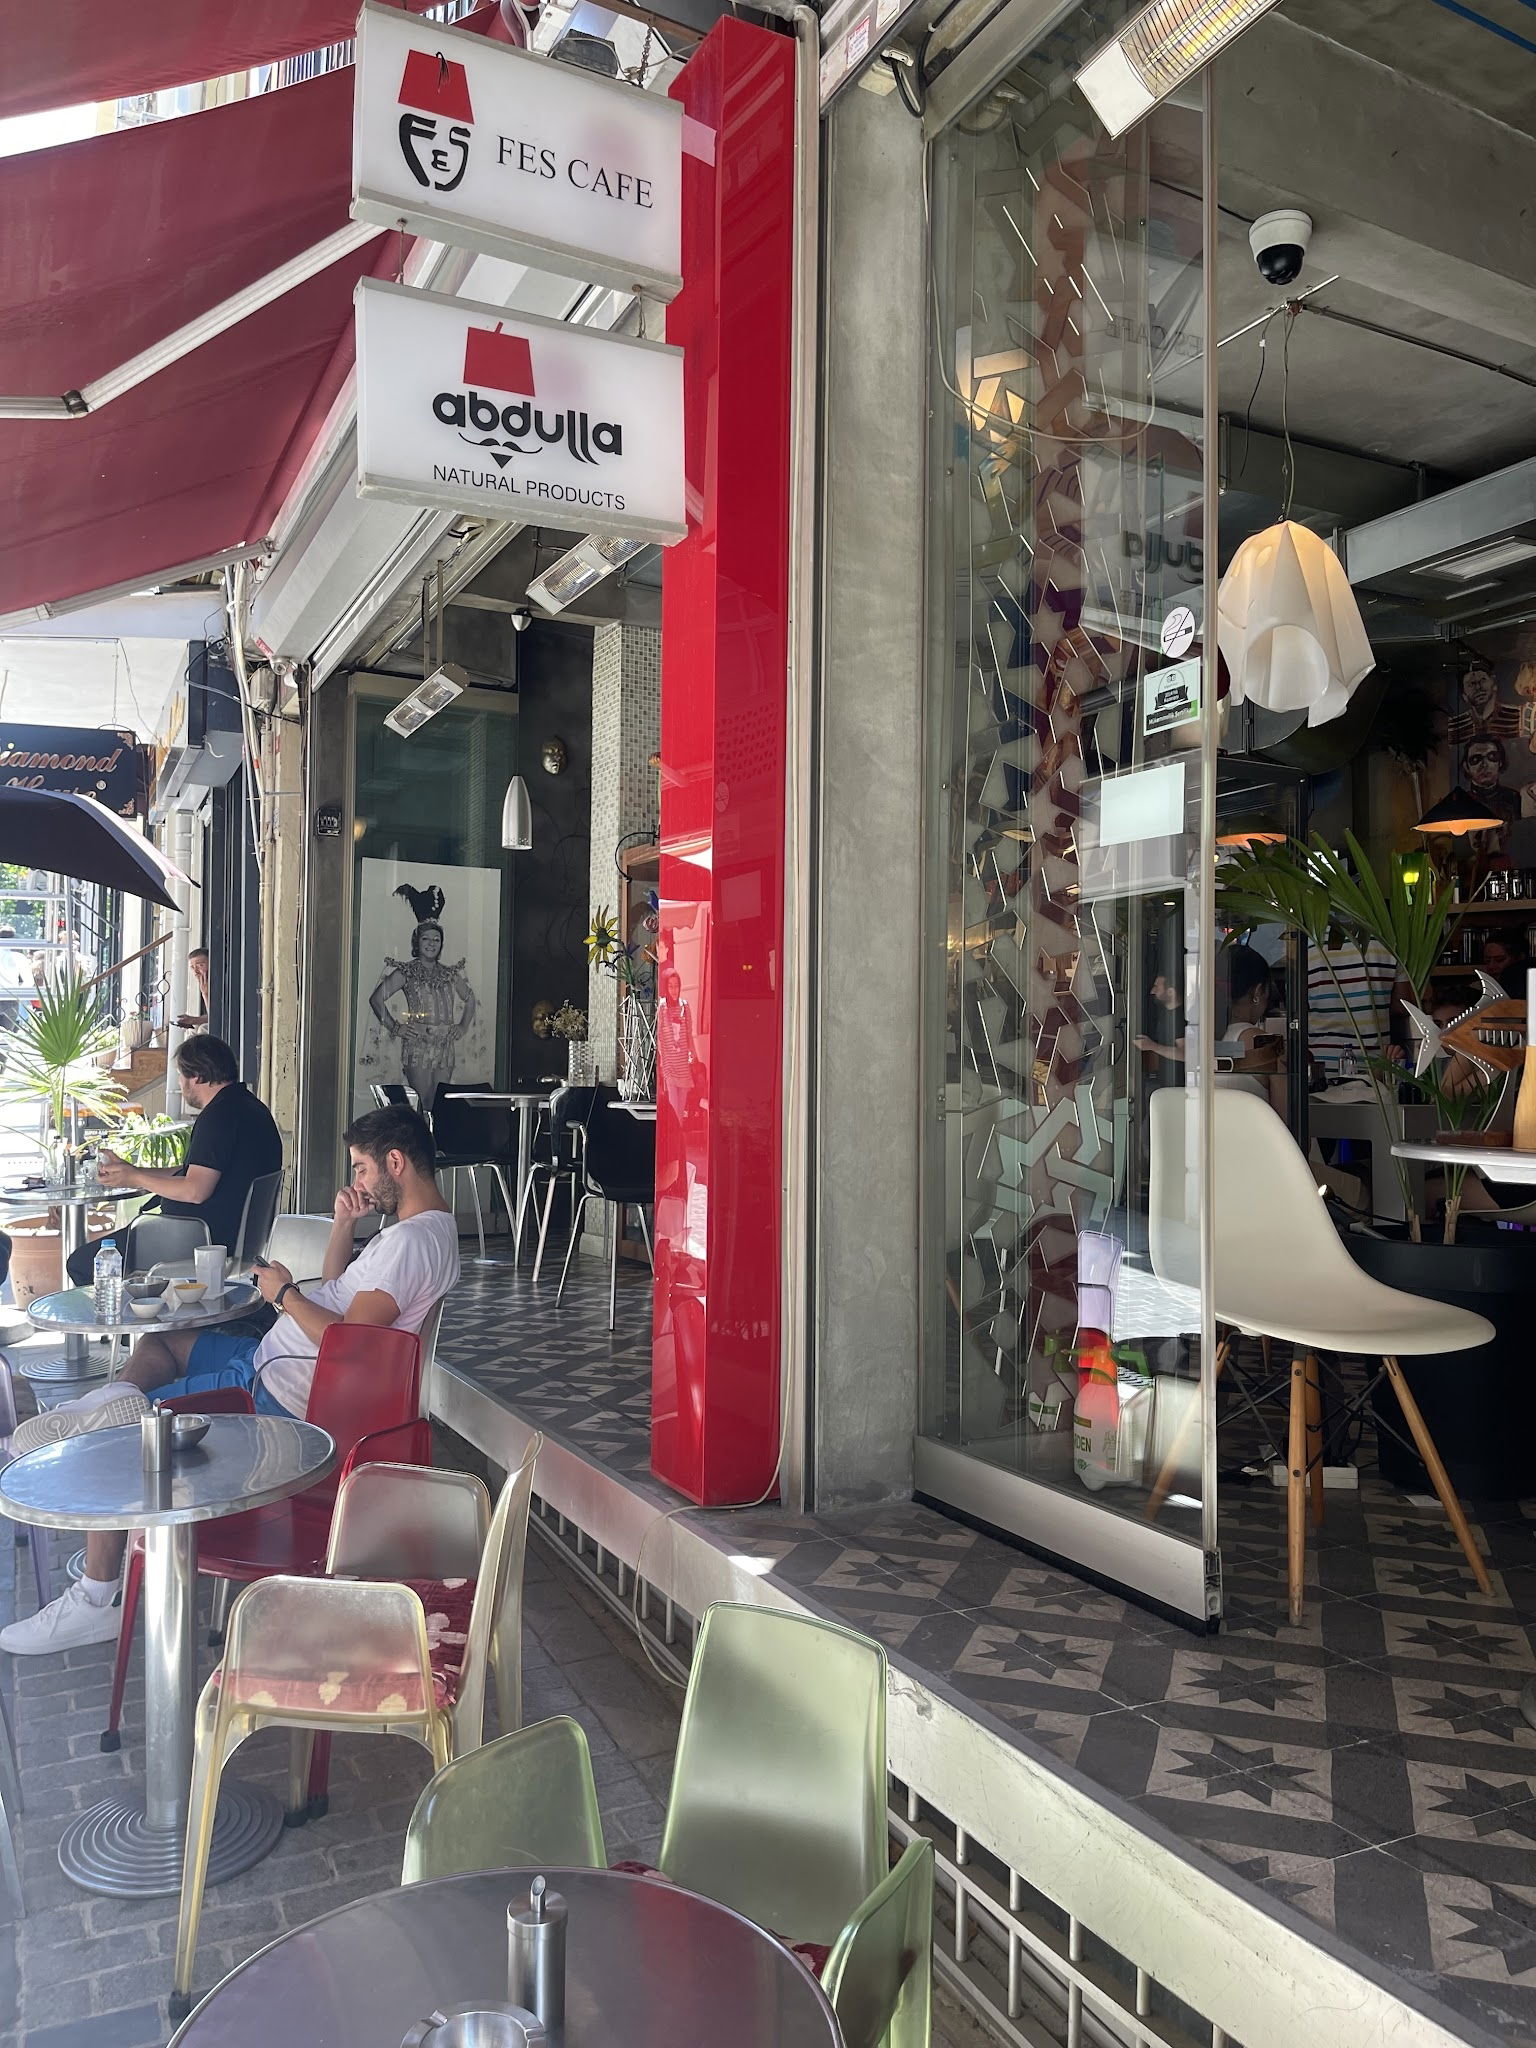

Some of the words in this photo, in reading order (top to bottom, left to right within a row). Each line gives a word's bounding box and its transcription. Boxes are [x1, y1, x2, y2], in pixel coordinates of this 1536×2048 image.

[495, 134, 558, 180] FES
[567, 158, 655, 209] CAFE
[432, 391, 623, 466] abdulla
[433, 464, 521, 495] NATURAL
[526, 480, 626, 511] PRODUCTS
[0, 742, 124, 773] iamond
[1076, 1434, 1091, 1453] DEN
